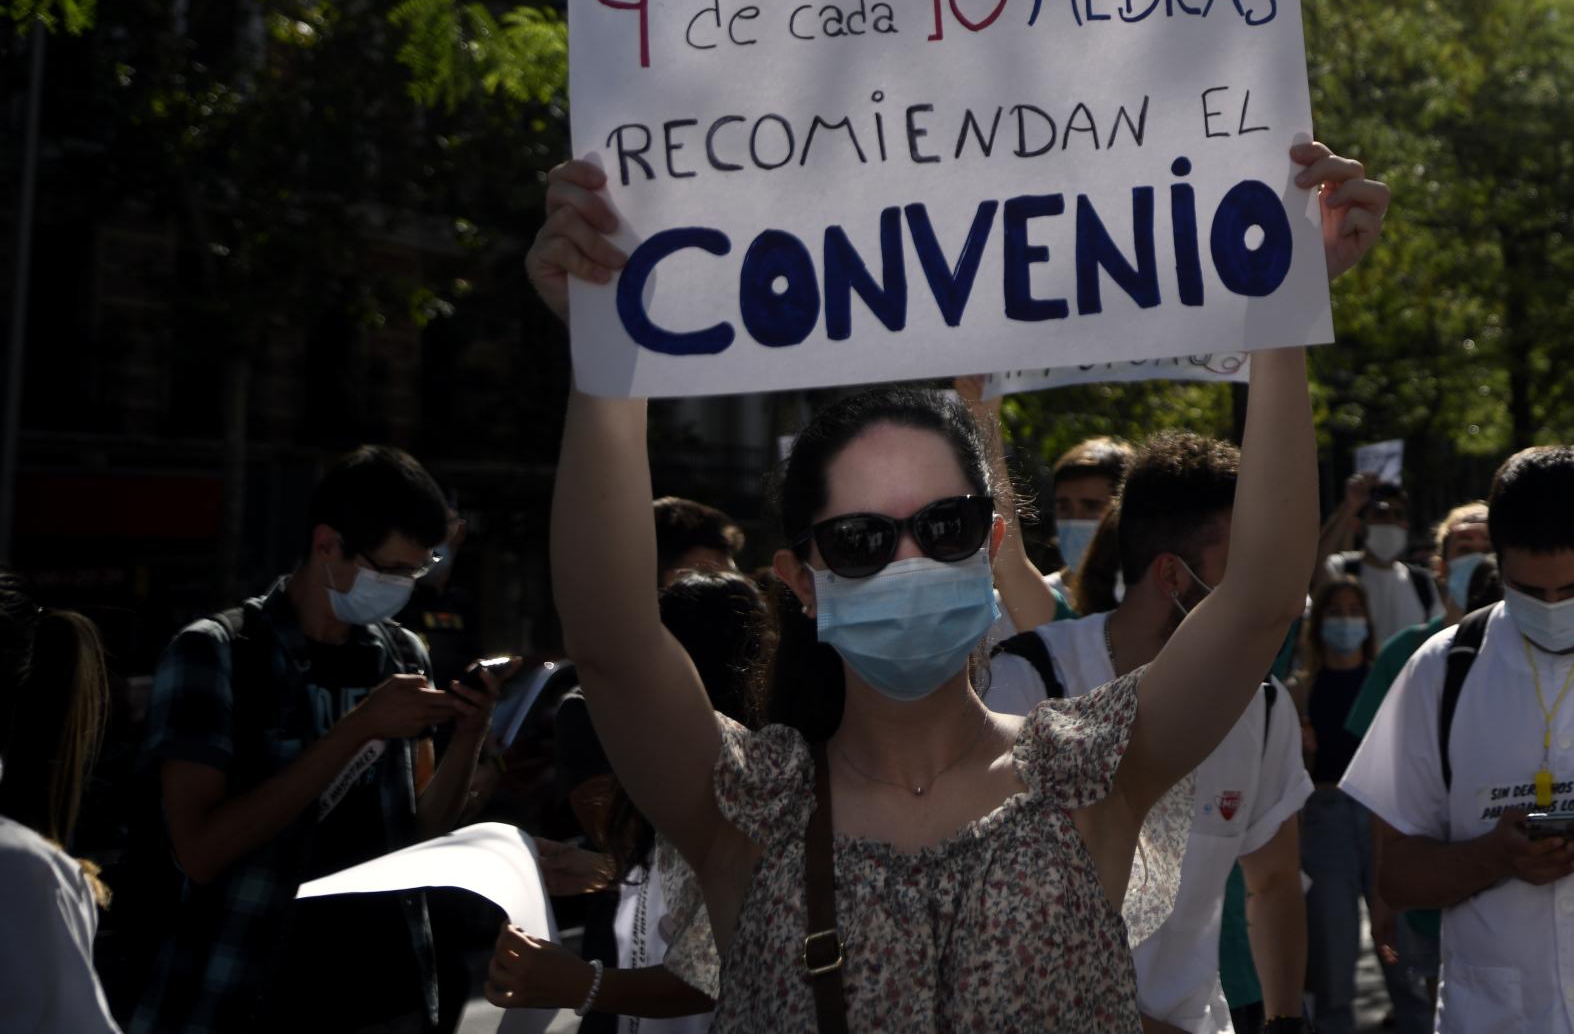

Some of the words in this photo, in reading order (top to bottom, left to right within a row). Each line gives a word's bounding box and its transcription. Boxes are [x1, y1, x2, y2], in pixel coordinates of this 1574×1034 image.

[606, 90, 1149, 185] RECOMIENDAN
[1202, 85, 1271, 139] EL
[616, 156, 1293, 356] CONVENIO
[1491, 786, 1510, 800] SIN
